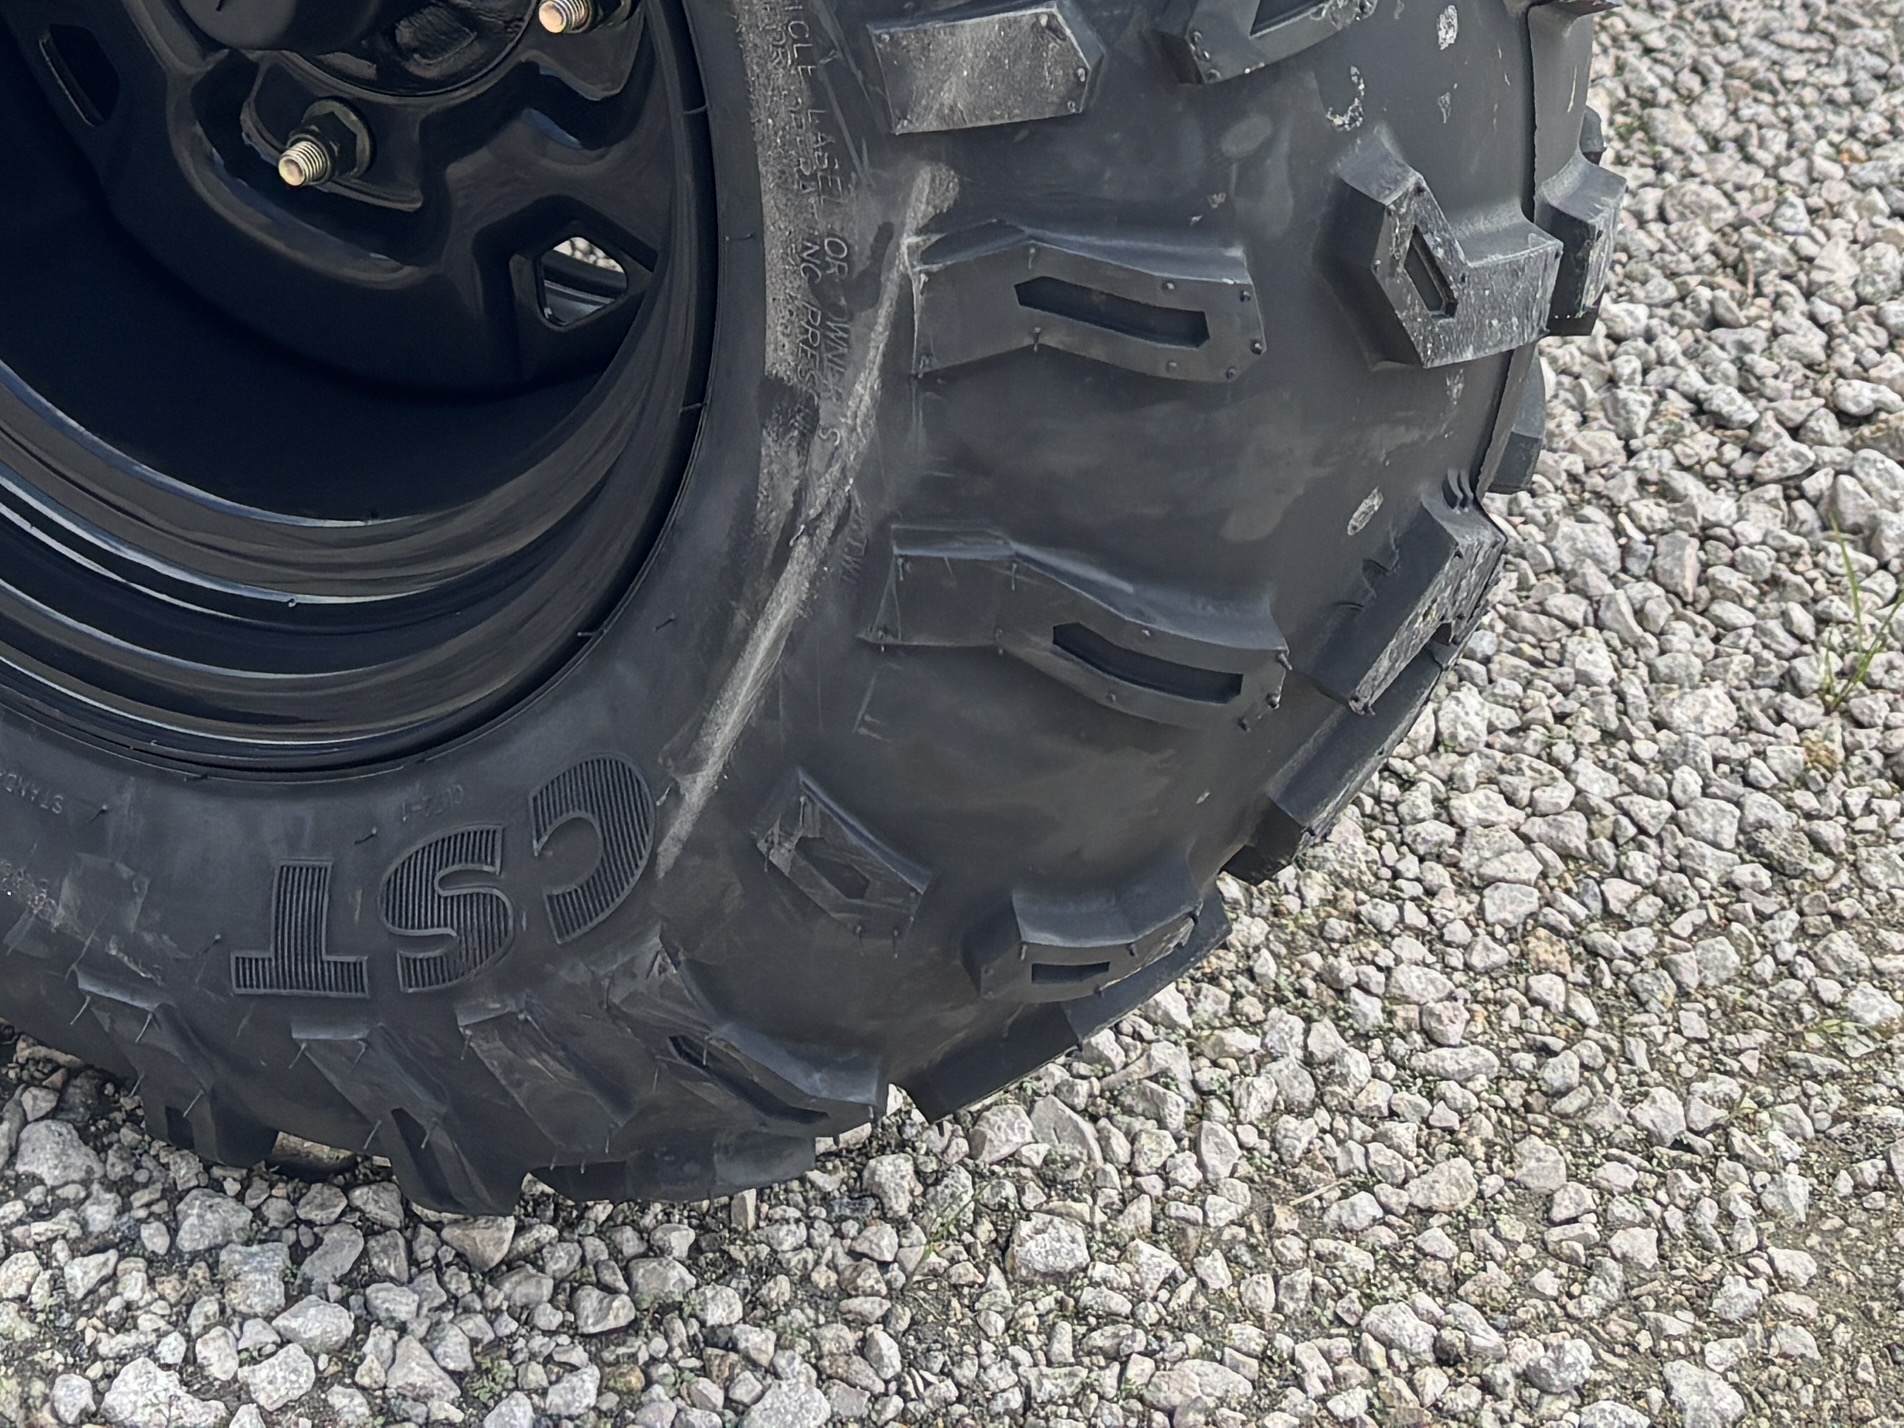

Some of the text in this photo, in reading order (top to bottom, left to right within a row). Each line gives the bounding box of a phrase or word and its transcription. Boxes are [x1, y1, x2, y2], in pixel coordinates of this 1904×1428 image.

[806, 107, 843, 210] LABEL
[823, 235, 850, 283] OR
[230, 752, 656, 998] CST
